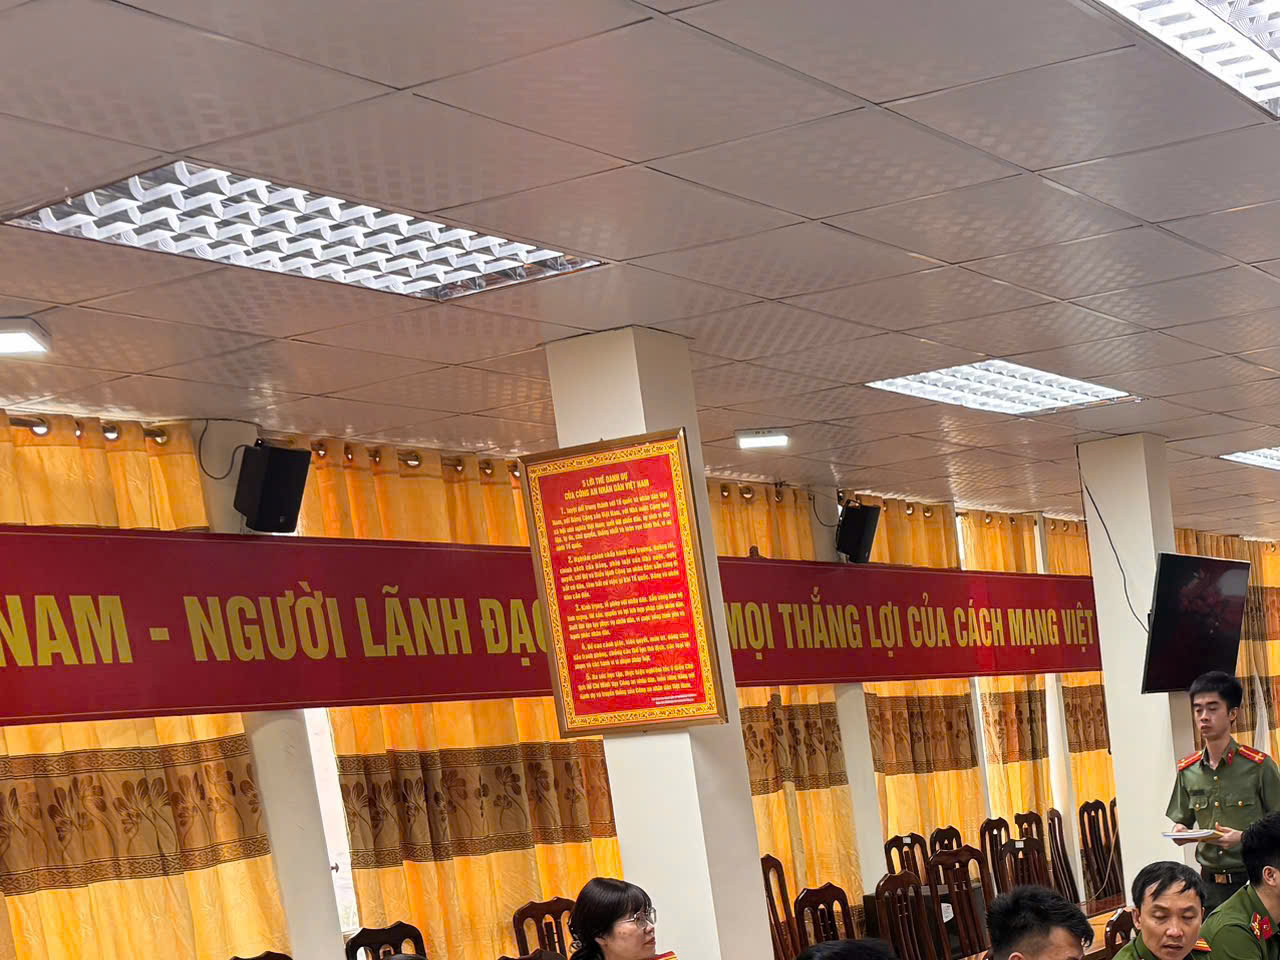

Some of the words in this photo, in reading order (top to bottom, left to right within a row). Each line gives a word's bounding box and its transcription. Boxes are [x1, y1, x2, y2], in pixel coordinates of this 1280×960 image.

[0, 595, 132, 667] NAM
[184, 581, 346, 661] NGƯỜI
[355, 585, 470, 657] LÃNH
[778, 587, 863, 648] THẮNG
[866, 602, 903, 657] LỢI
[908, 593, 951, 647] CỦA
[954, 600, 1005, 647] CÁCH
[1008, 609, 1059, 654] MẠNG
[1060, 602, 1094, 652] VIỆT
